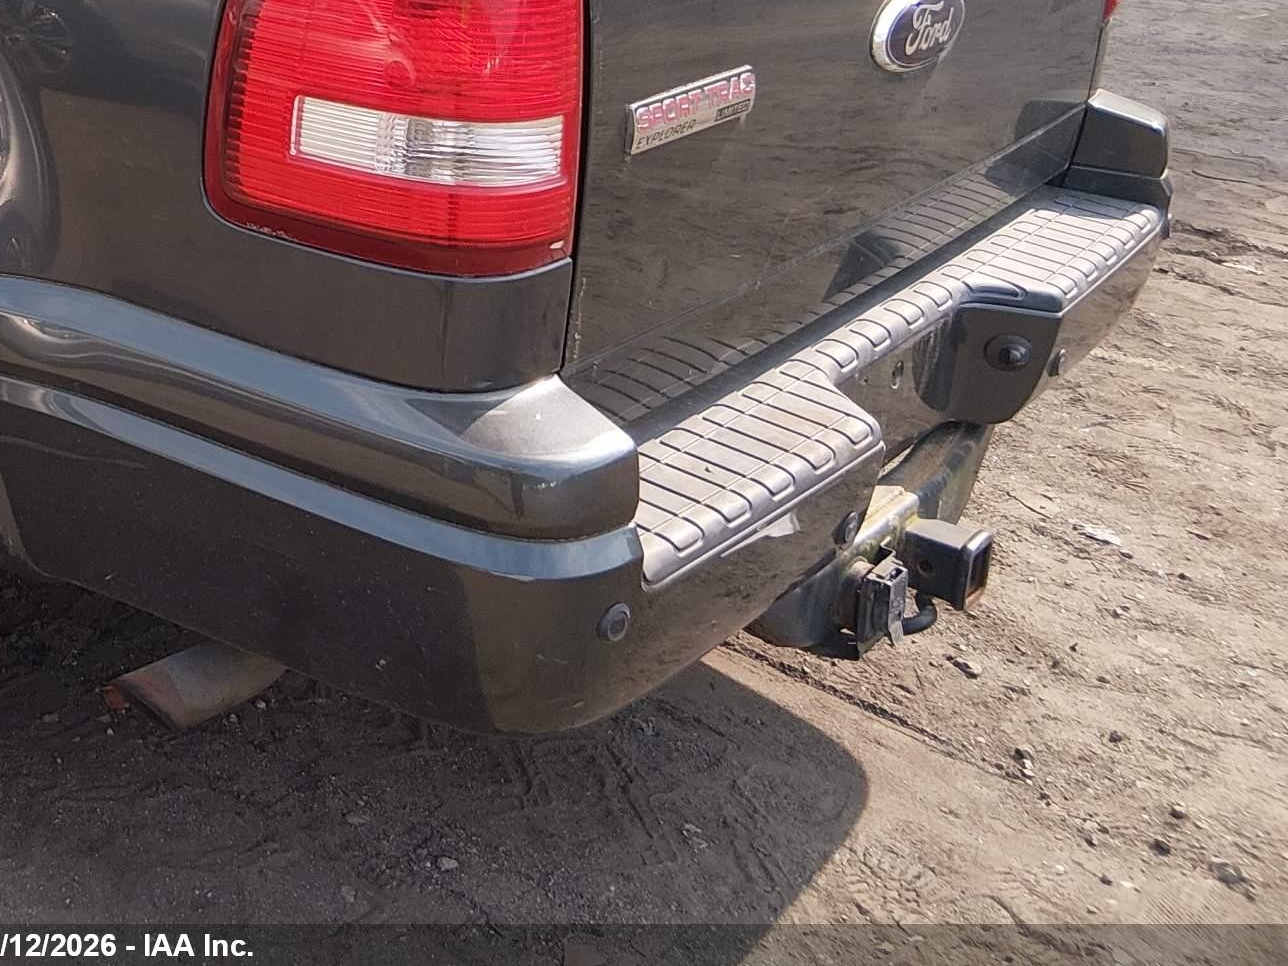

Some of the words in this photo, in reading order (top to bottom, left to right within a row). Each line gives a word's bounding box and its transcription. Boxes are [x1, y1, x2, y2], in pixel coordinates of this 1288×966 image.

[905, 1, 954, 55] Ford
[636, 89, 703, 130] SPORT
[704, 72, 755, 107] TRAC
[635, 119, 697, 150] EXPLORER
